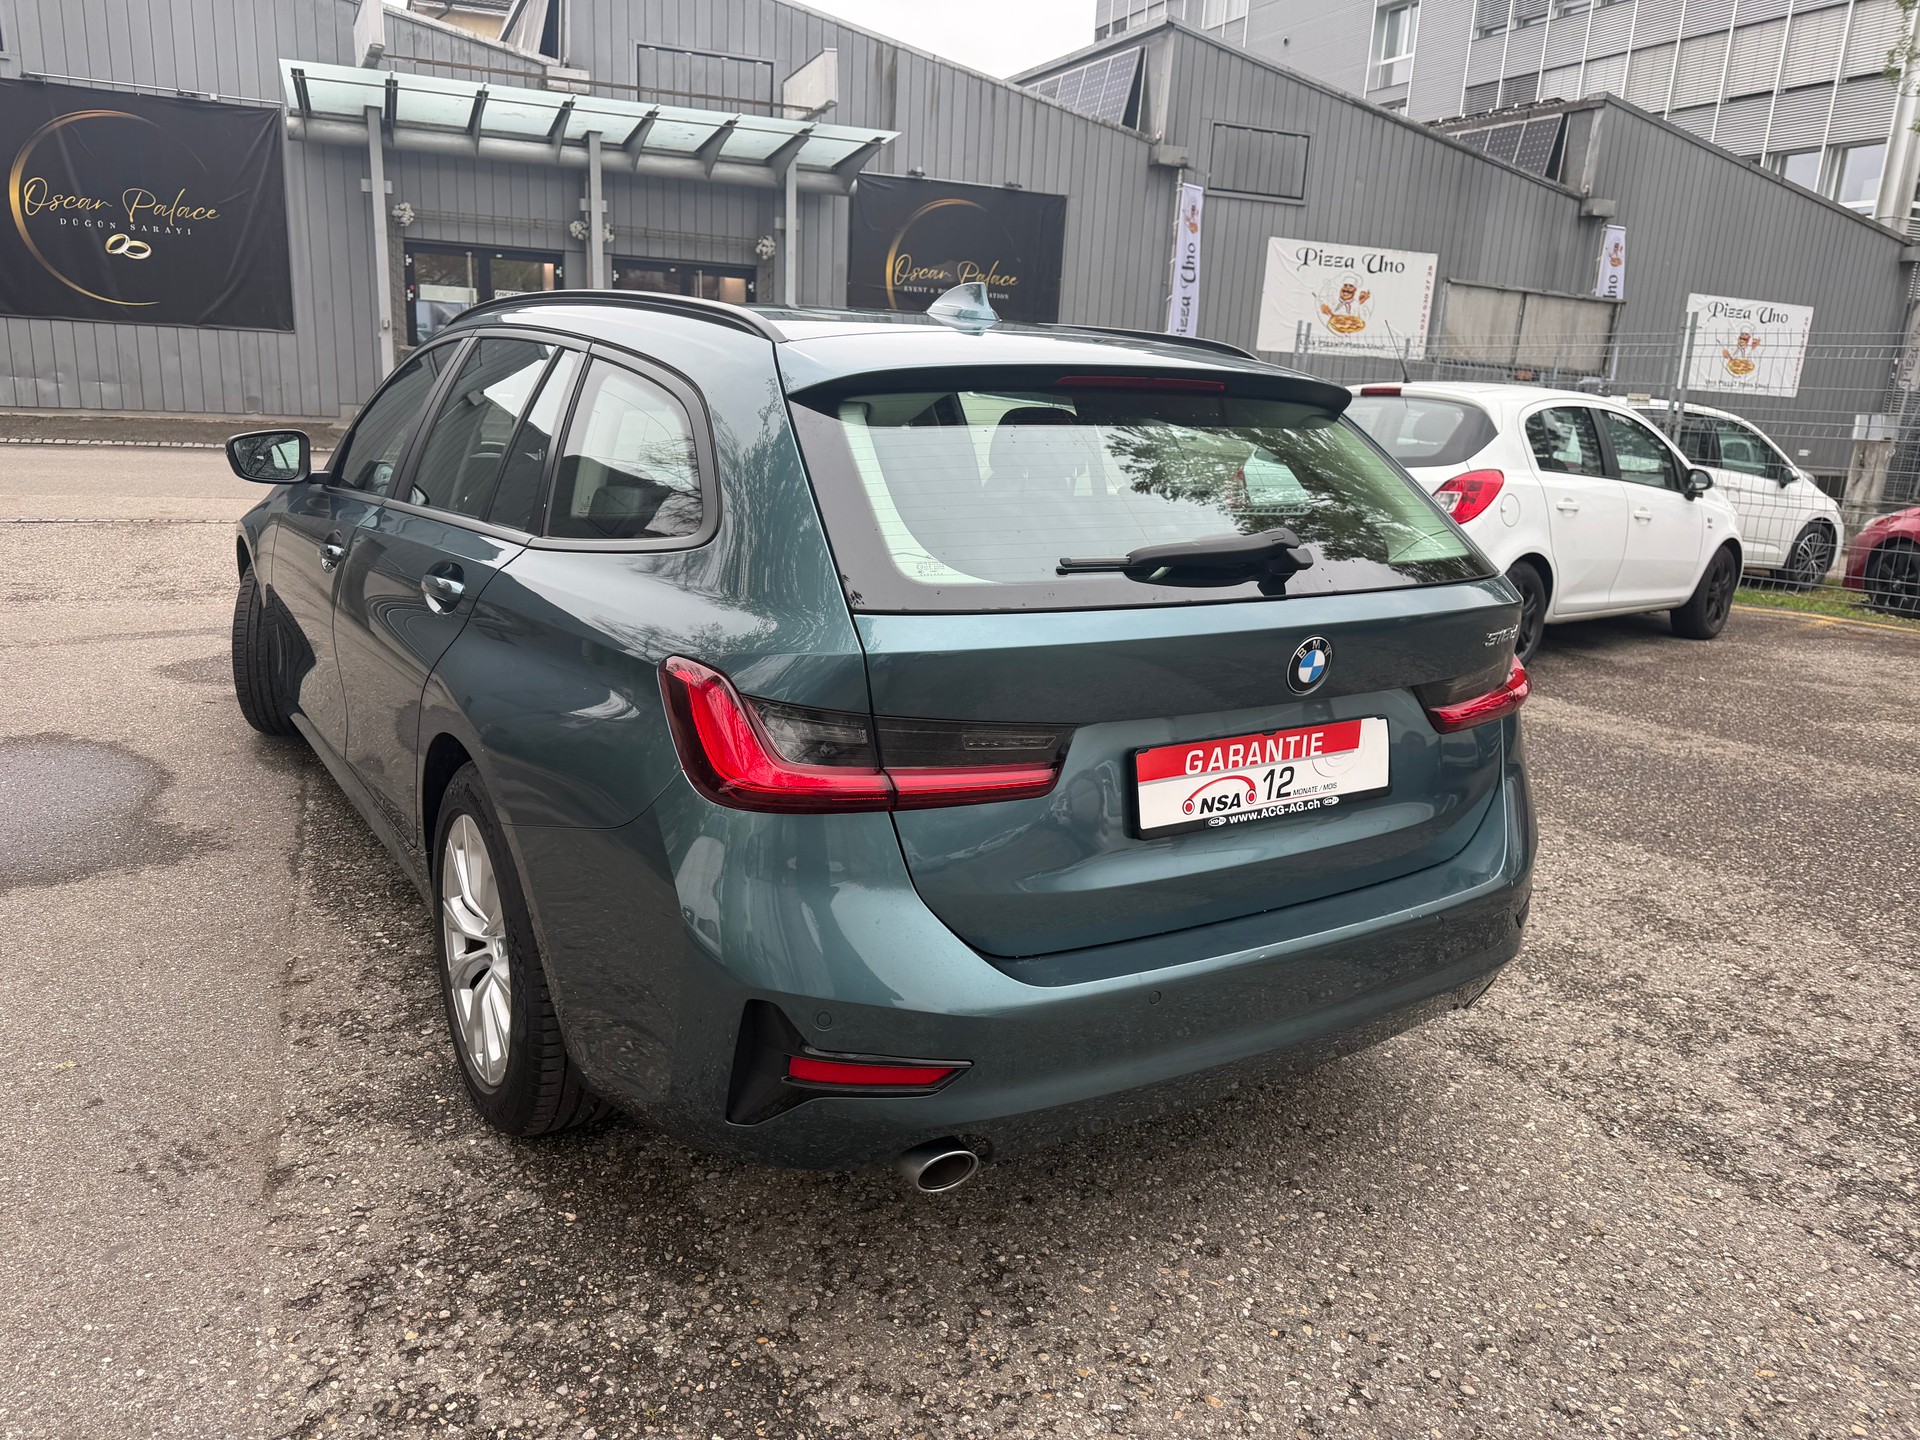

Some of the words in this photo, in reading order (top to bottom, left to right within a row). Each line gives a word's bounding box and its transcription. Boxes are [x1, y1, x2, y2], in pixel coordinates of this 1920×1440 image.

[24, 177, 113, 216] Oscar
[122, 187, 221, 227] Palace
[895, 255, 951, 286] Oscar
[958, 260, 1018, 288] Palace
[1180, 243, 1196, 289] Uno
[1295, 246, 1355, 272] Pizza
[1361, 253, 1406, 275] Uno
[903, 285, 928, 293] EVENT
[1176, 297, 1192, 336] izza
[1707, 301, 1751, 322] Pizza
[1756, 306, 1789, 324] Uno
[1296, 639, 1331, 659] BMW
[1185, 732, 1324, 775] GARANTIE
[1262, 766, 1295, 801] 12
[1292, 785, 1319, 796] MONATE
[1323, 782, 1338, 791] MOIS
[1199, 792, 1241, 815] NSA
[1228, 799, 1321, 824] www.ACG-AG.ch
